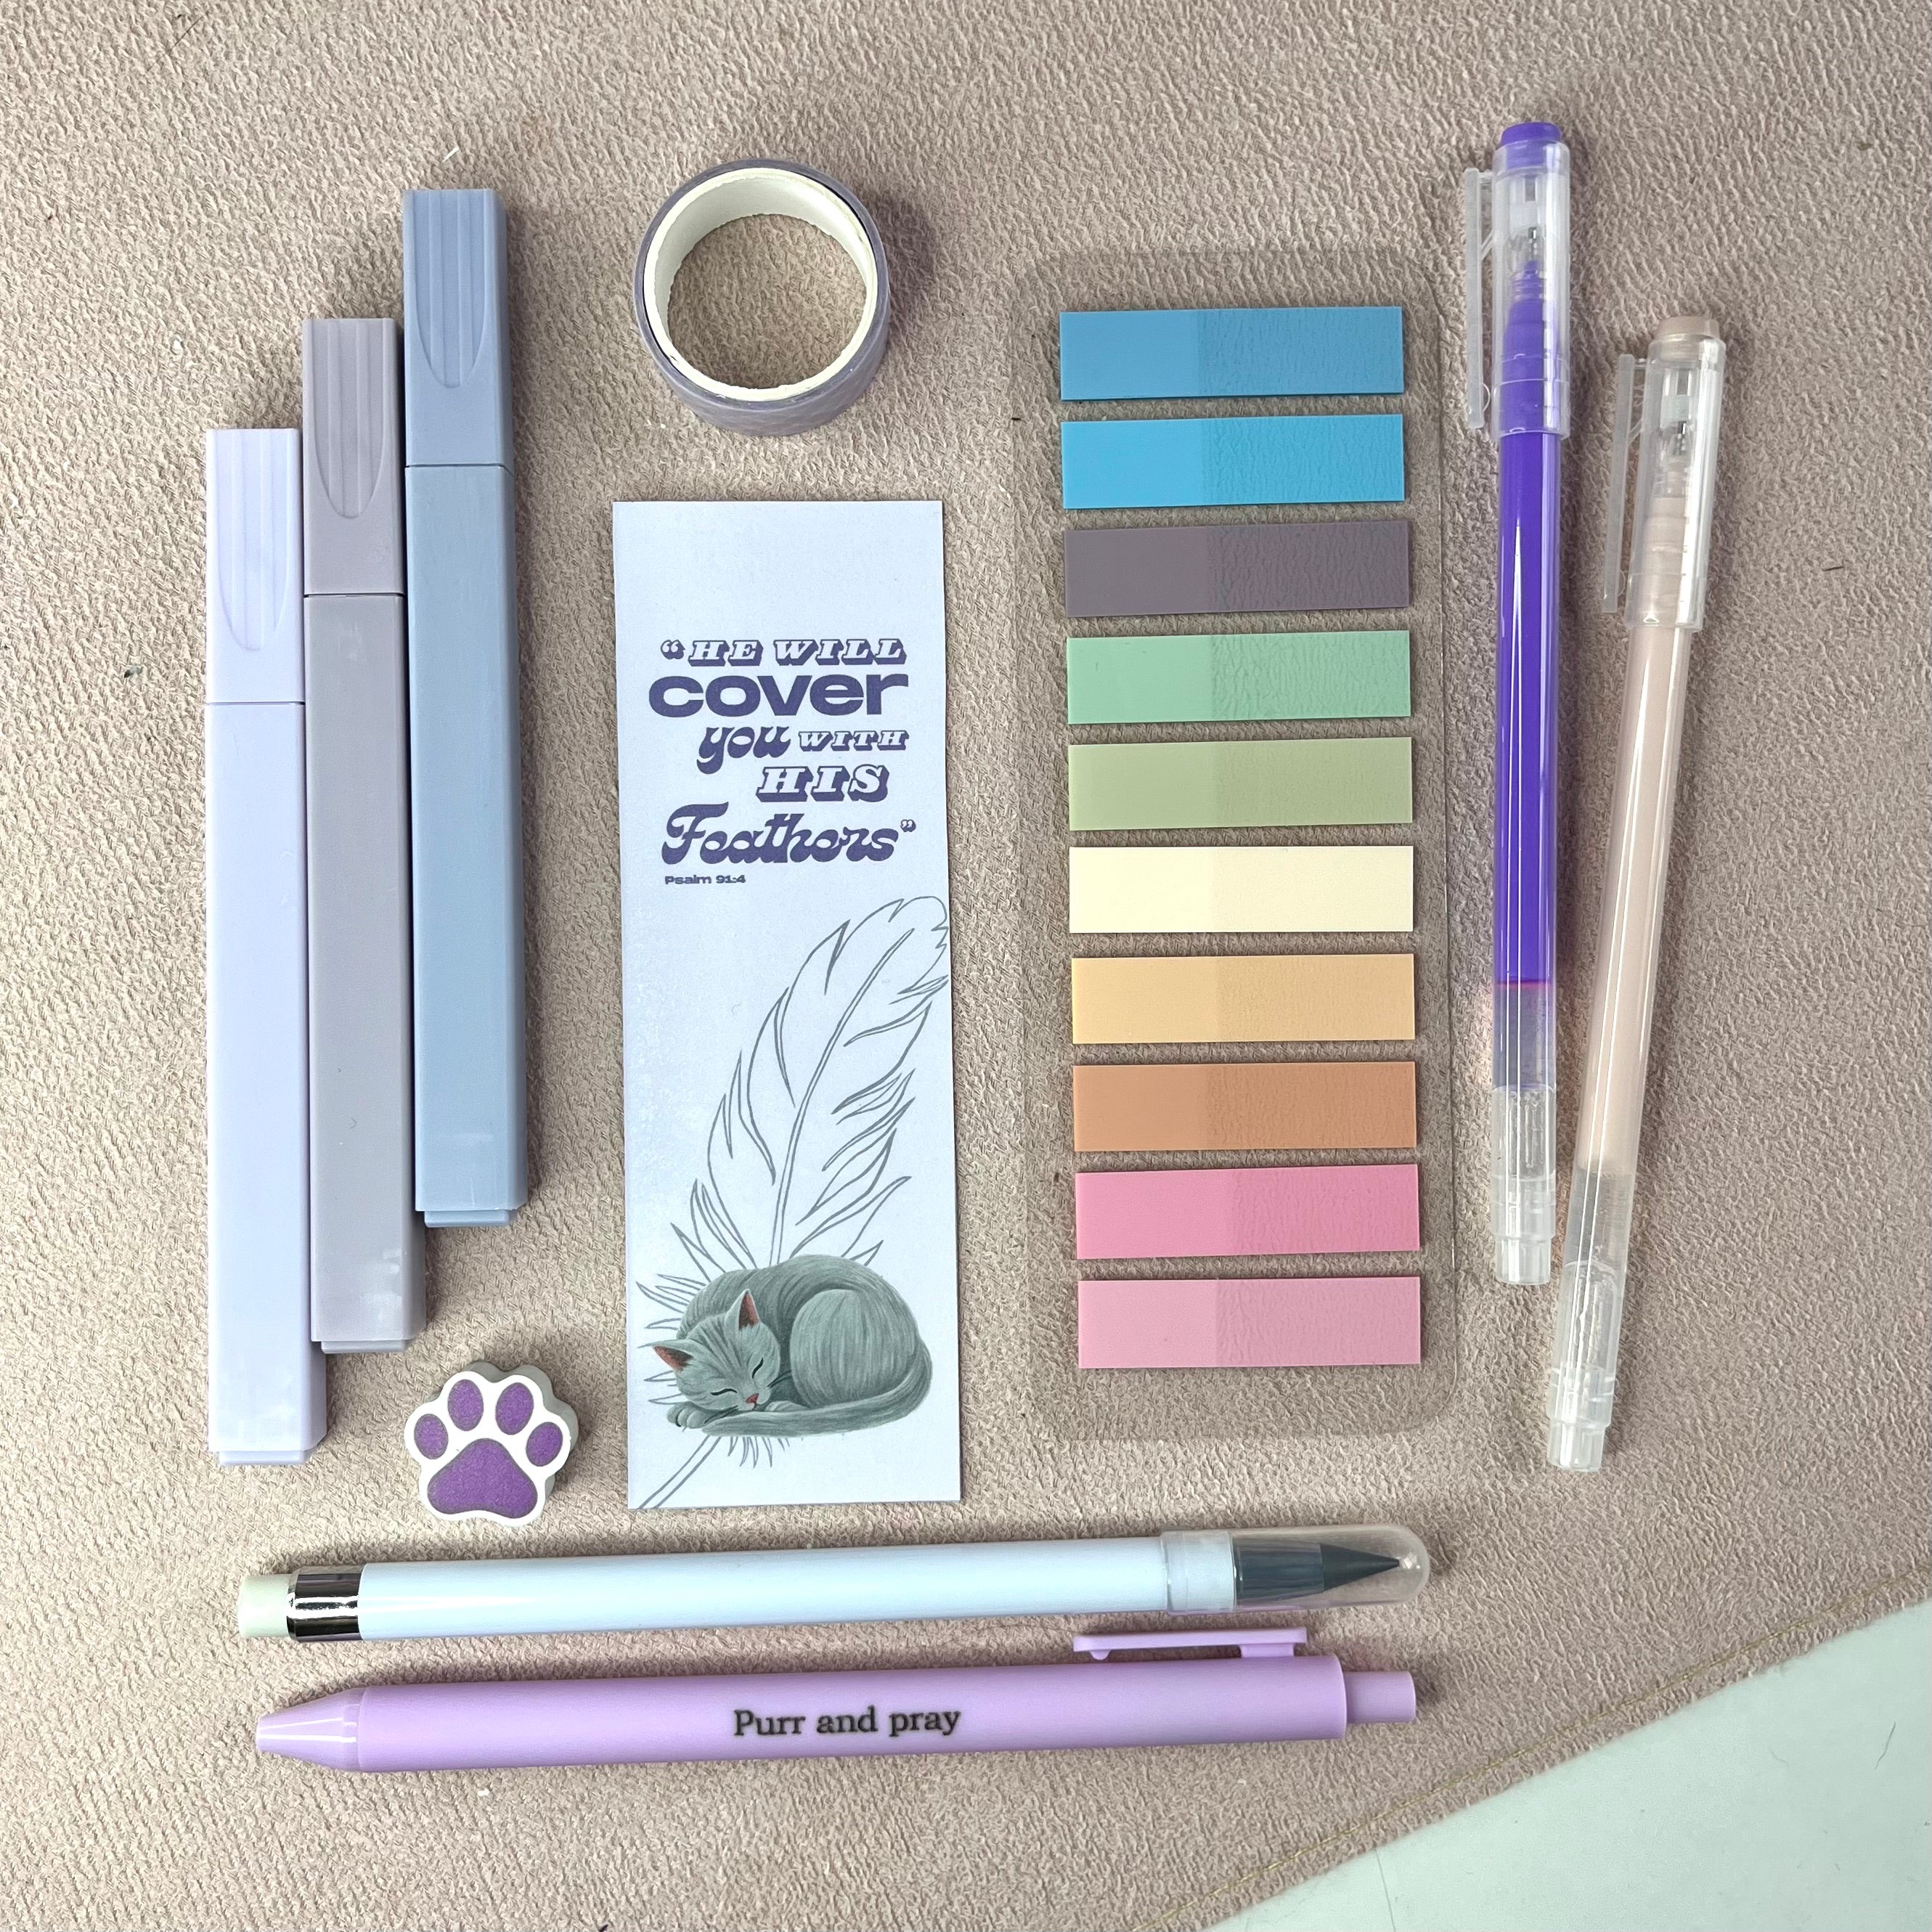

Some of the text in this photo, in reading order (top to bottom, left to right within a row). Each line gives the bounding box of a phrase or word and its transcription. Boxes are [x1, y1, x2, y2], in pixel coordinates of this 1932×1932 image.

[773, 638, 907, 665] WILL
[649, 674, 908, 717] cover
[697, 726, 909, 774] you WITH
[756, 764, 889, 802] HIS
[664, 874, 746, 884] Psalm 91:4
[734, 1705, 961, 1737] Purr and pray
